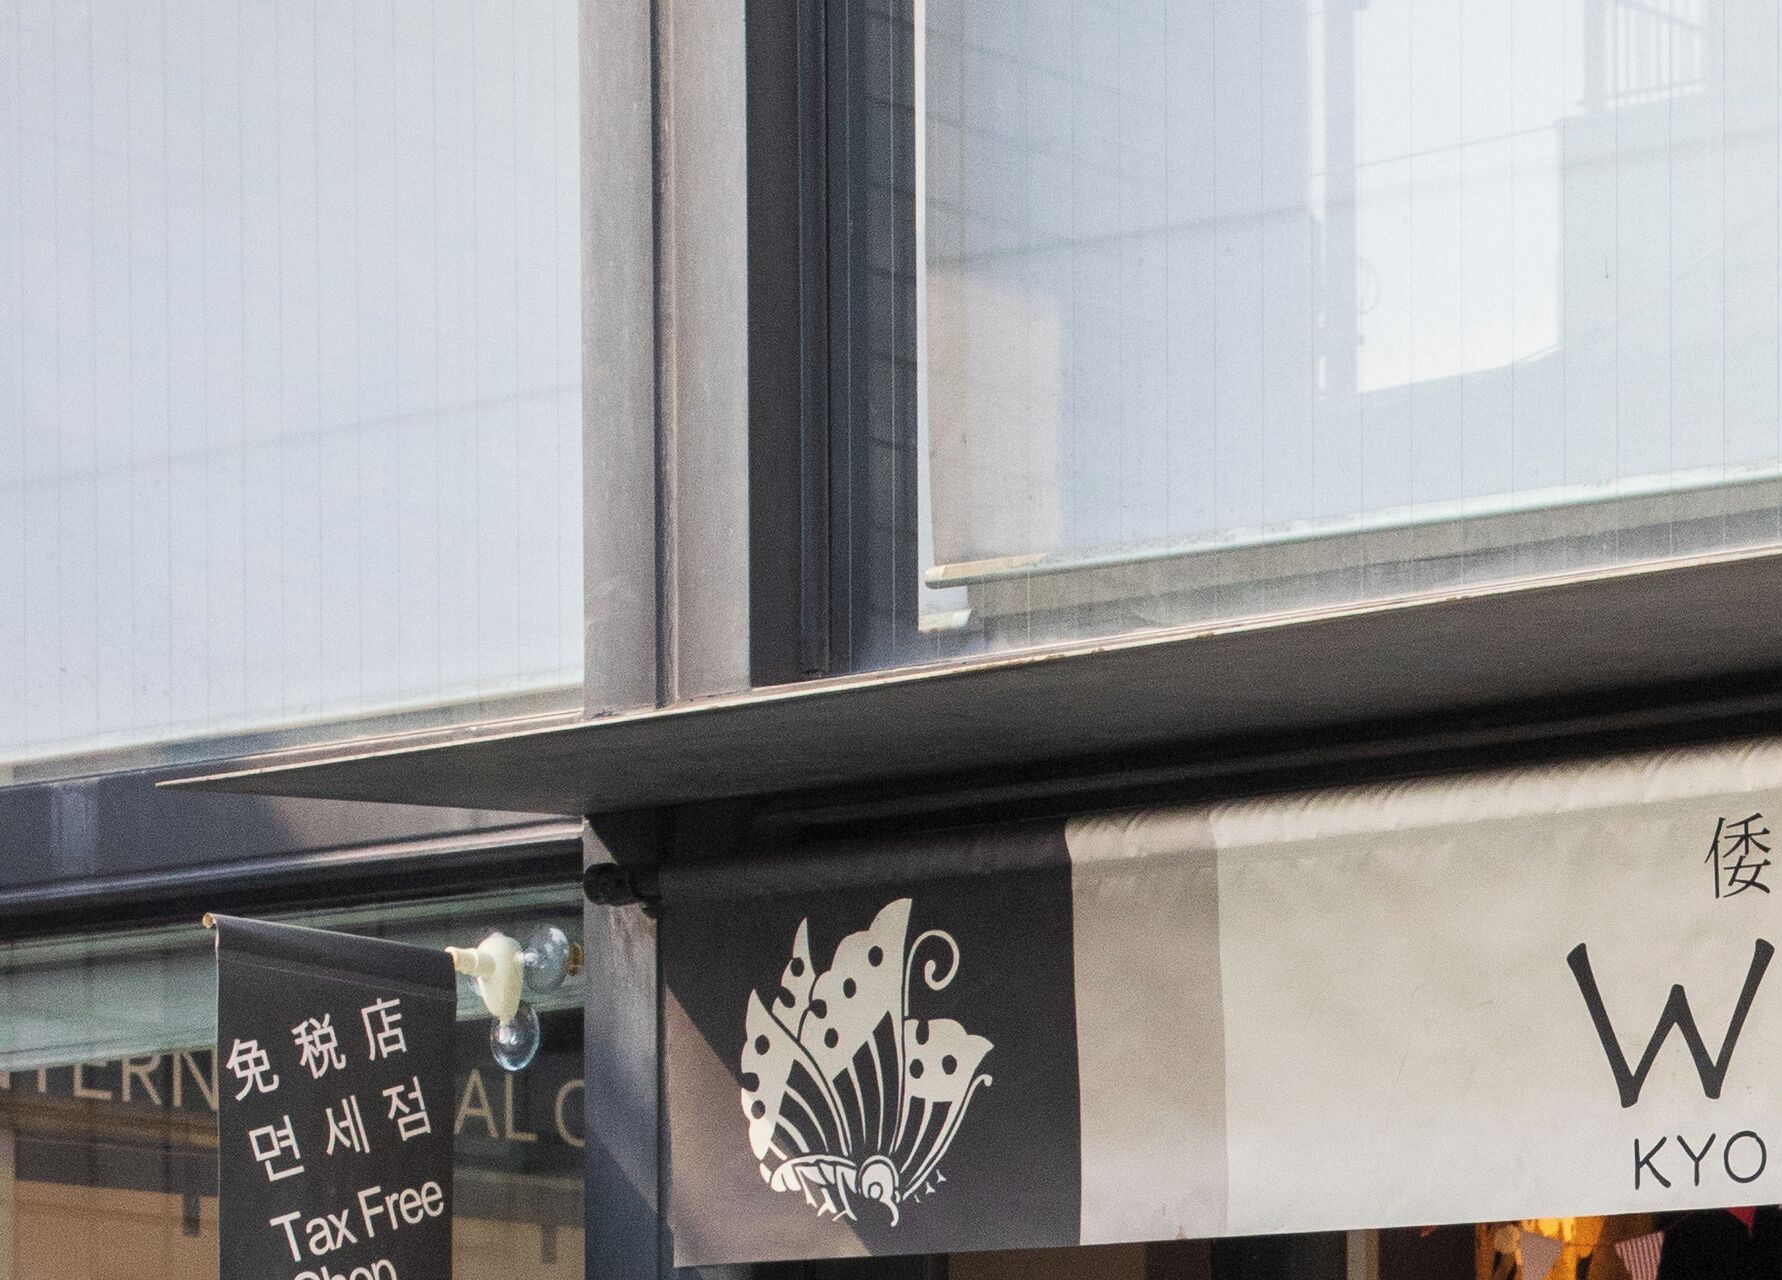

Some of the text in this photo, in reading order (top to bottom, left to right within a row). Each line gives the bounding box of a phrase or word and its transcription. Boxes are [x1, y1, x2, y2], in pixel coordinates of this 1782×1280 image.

[226, 998, 408, 1101] 免税店
[249, 1076, 432, 1183] 면세점
[1634, 1131, 1769, 1190] KYO
[270, 1180, 444, 1264] Tax Free
